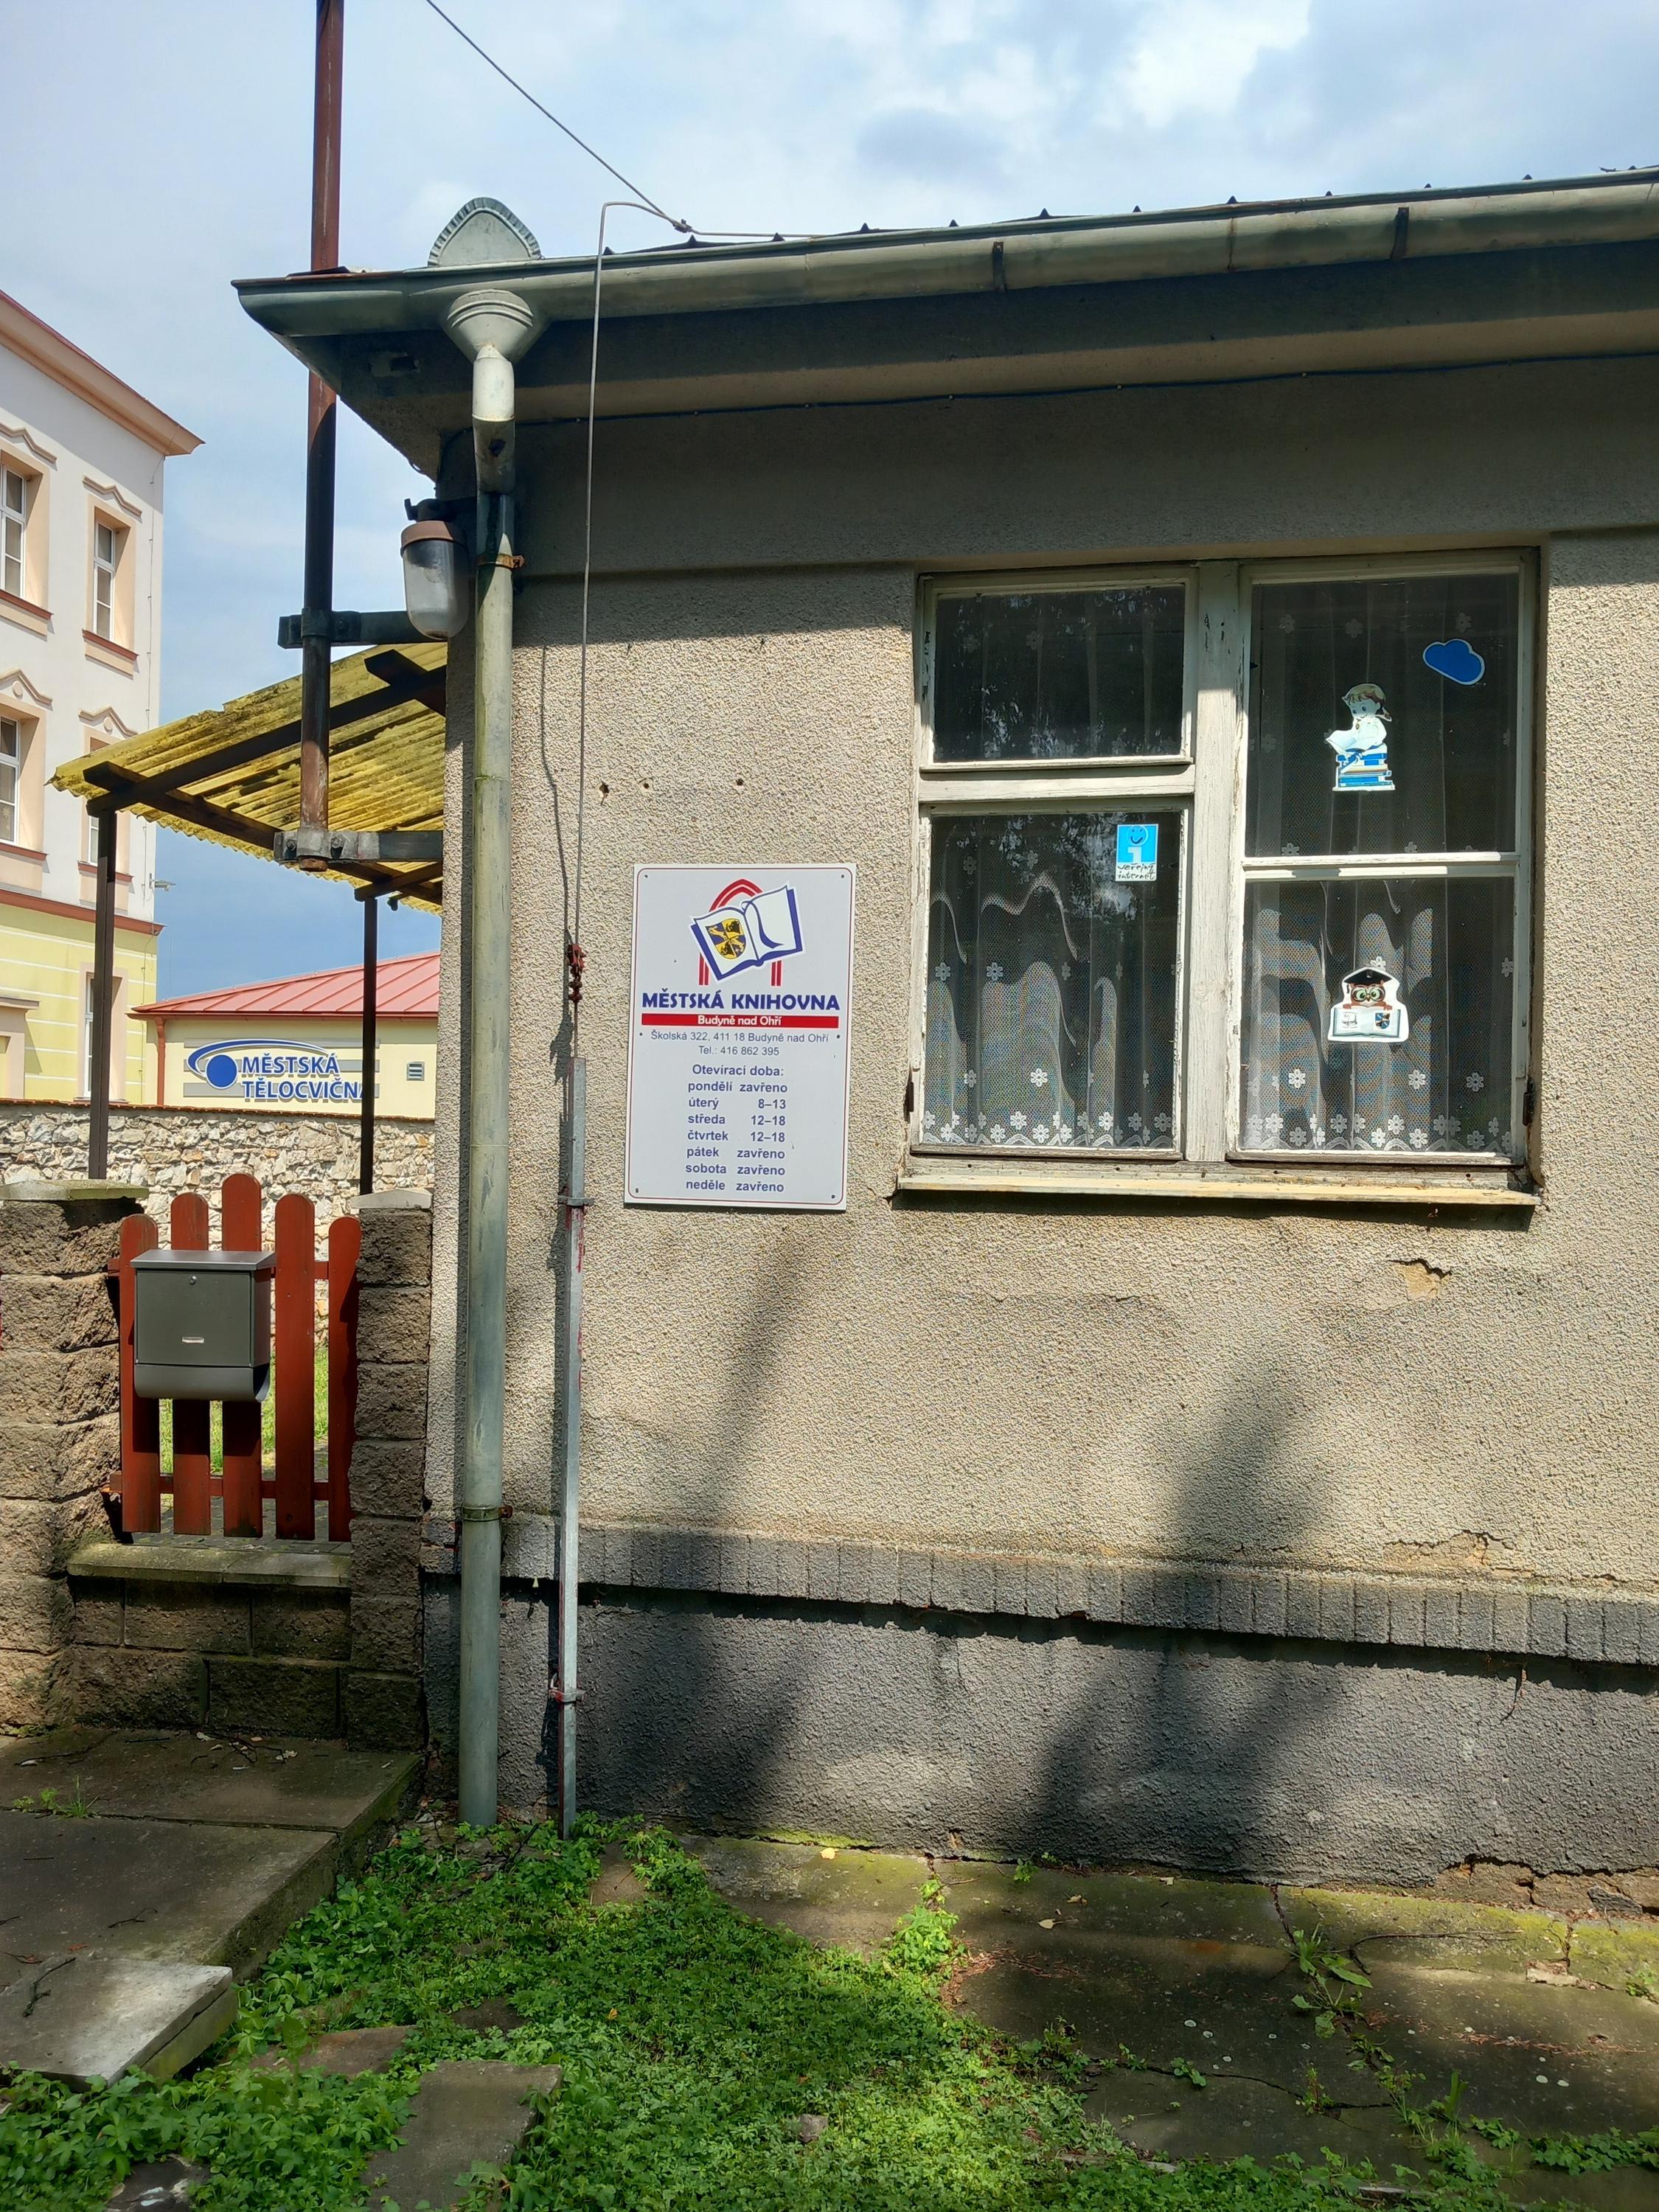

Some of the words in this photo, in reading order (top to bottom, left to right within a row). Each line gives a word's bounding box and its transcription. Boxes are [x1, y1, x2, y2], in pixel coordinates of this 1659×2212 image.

[1118, 871, 1155, 880] internet
[642, 988, 725, 1009] MĚSTSKÁ
[731, 993, 840, 1011] KNIHOVNA
[698, 1015, 736, 1026] Budyně
[738, 1016, 758, 1026] nad
[759, 1016, 782, 1026] Ohří
[651, 1029, 687, 1040] Školská
[690, 1032, 711, 1042] 322,
[713, 1032, 730, 1041] 411
[734, 1033, 745, 1041] 18
[748, 1033, 784, 1044] Budyně
[787, 1034, 805, 1043] nad
[808, 1034, 829, 1043] Ohří
[699, 1046, 717, 1054] Tel.:
[720, 1046, 738, 1055] 416
[741, 1046, 759, 1055] 862
[762, 1046, 779, 1056] 395
[242, 1053, 339, 1074] MĚSTSKÁ
[692, 1064, 746, 1075] Otevírací
[750, 1065, 784, 1076] doba:
[688, 1081, 732, 1093] pondělí
[740, 1082, 787, 1092] zavřeno
[689, 1097, 719, 1110] úterý
[688, 1113, 726, 1124] středa
[687, 1130, 728, 1141] čtvrtek
[686, 1147, 719, 1158] pátek
[737, 1148, 785, 1158] zavřeno
[686, 1164, 726, 1174] sobota
[737, 1165, 785, 1175] zavřeno
[686, 1180, 726, 1190] neděle
[736, 1181, 784, 1192] zavřeno
